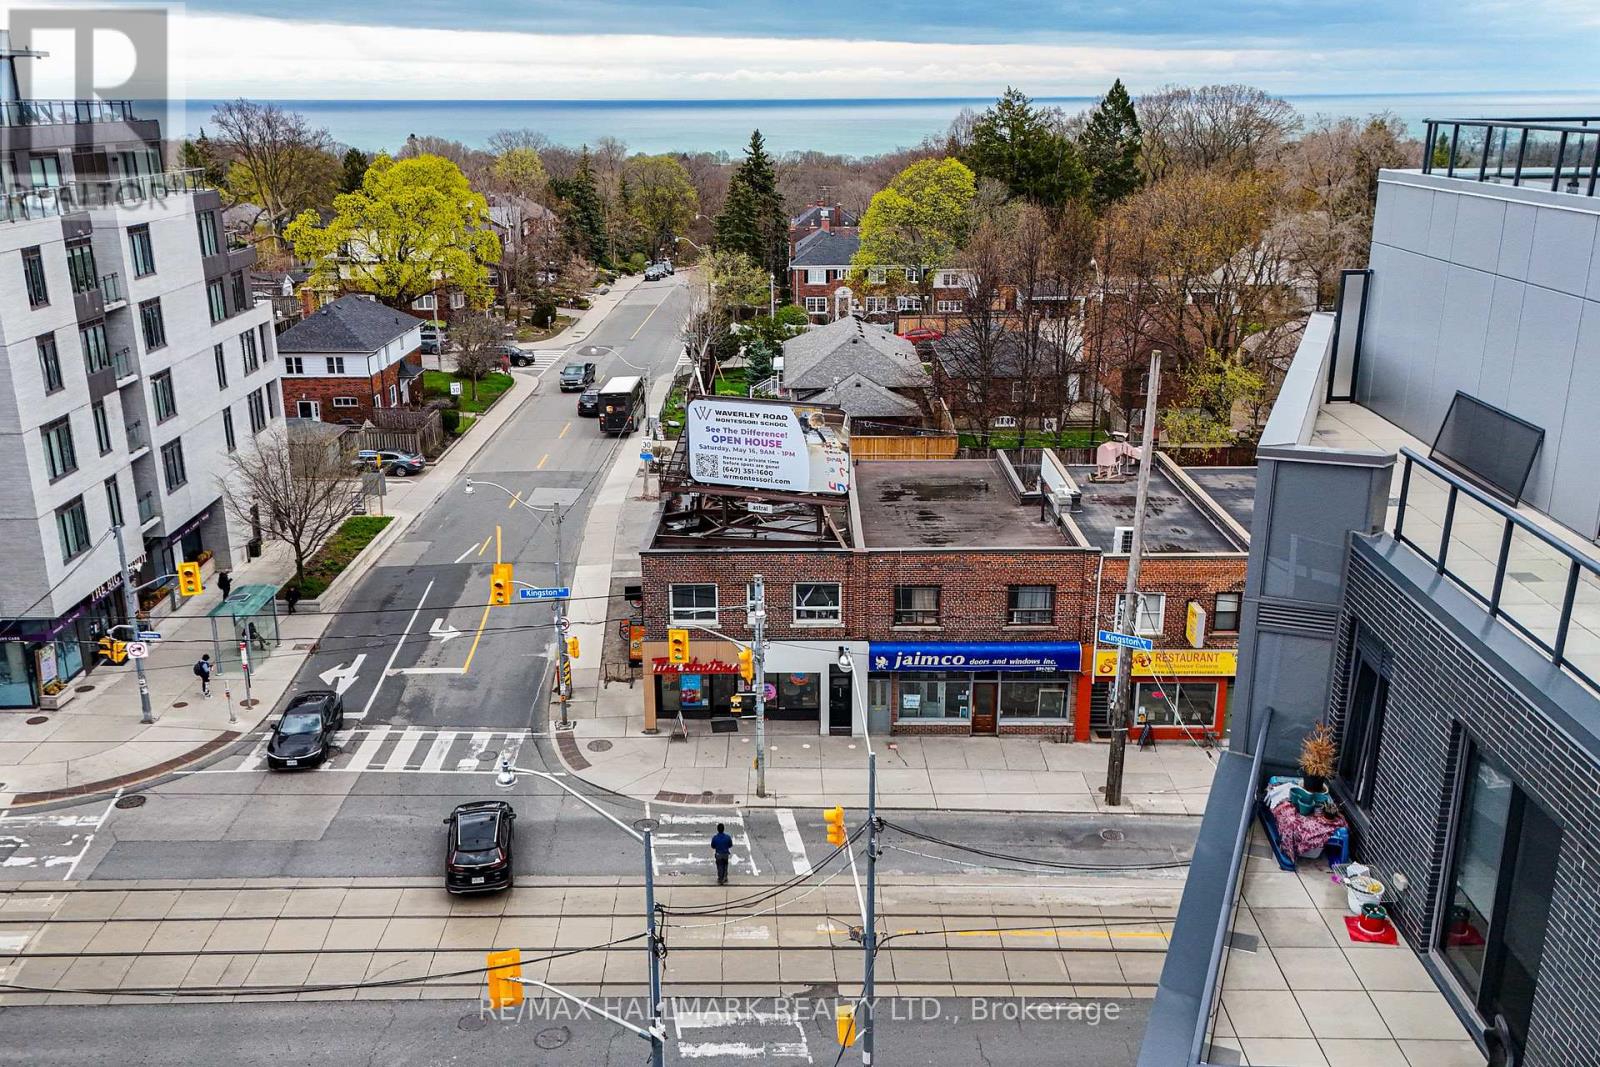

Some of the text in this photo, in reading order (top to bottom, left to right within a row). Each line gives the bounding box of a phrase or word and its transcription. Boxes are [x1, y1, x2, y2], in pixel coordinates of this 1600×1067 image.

[715, 410, 788, 421] WAVERLEY ROAD
[715, 417, 759, 426] MONTESSORI
[705, 426, 788, 439] See The Difference!
[642, 441, 652, 449] 30
[711, 435, 783, 448] OPEN HOUSE
[698, 443, 731, 453] Saturday,
[732, 446, 747, 454] May
[722, 466, 774, 477] (647) 351-1600
[722, 473, 791, 485] wrmontessori.com
[752, 504, 769, 512] astral
[91, 573, 121, 602] THE BIG
[525, 589, 558, 598] Kingston
[1105, 632, 1139, 647] Kingston
[894, 651, 966, 669] jaimco
[1155, 652, 1220, 663] RESTAURANT
